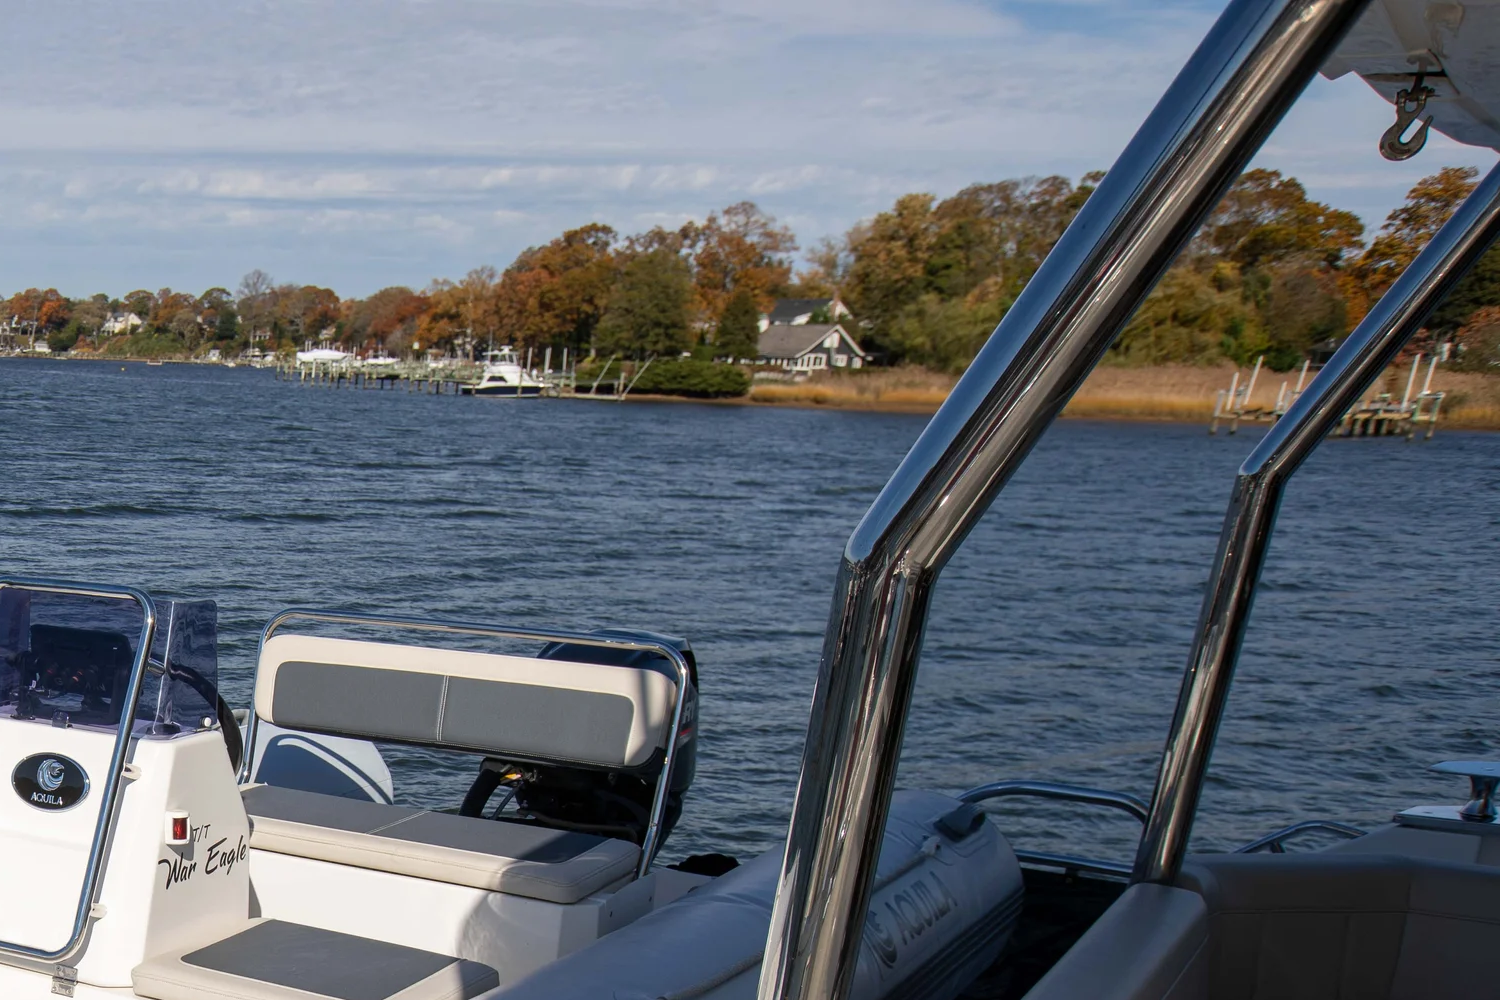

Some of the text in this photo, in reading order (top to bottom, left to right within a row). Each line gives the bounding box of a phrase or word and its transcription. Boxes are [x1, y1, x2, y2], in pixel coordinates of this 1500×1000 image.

[30, 791, 64, 806] AQUILA
[158, 835, 247, 890] War Eagle
[884, 870, 958, 945] AQUILA
